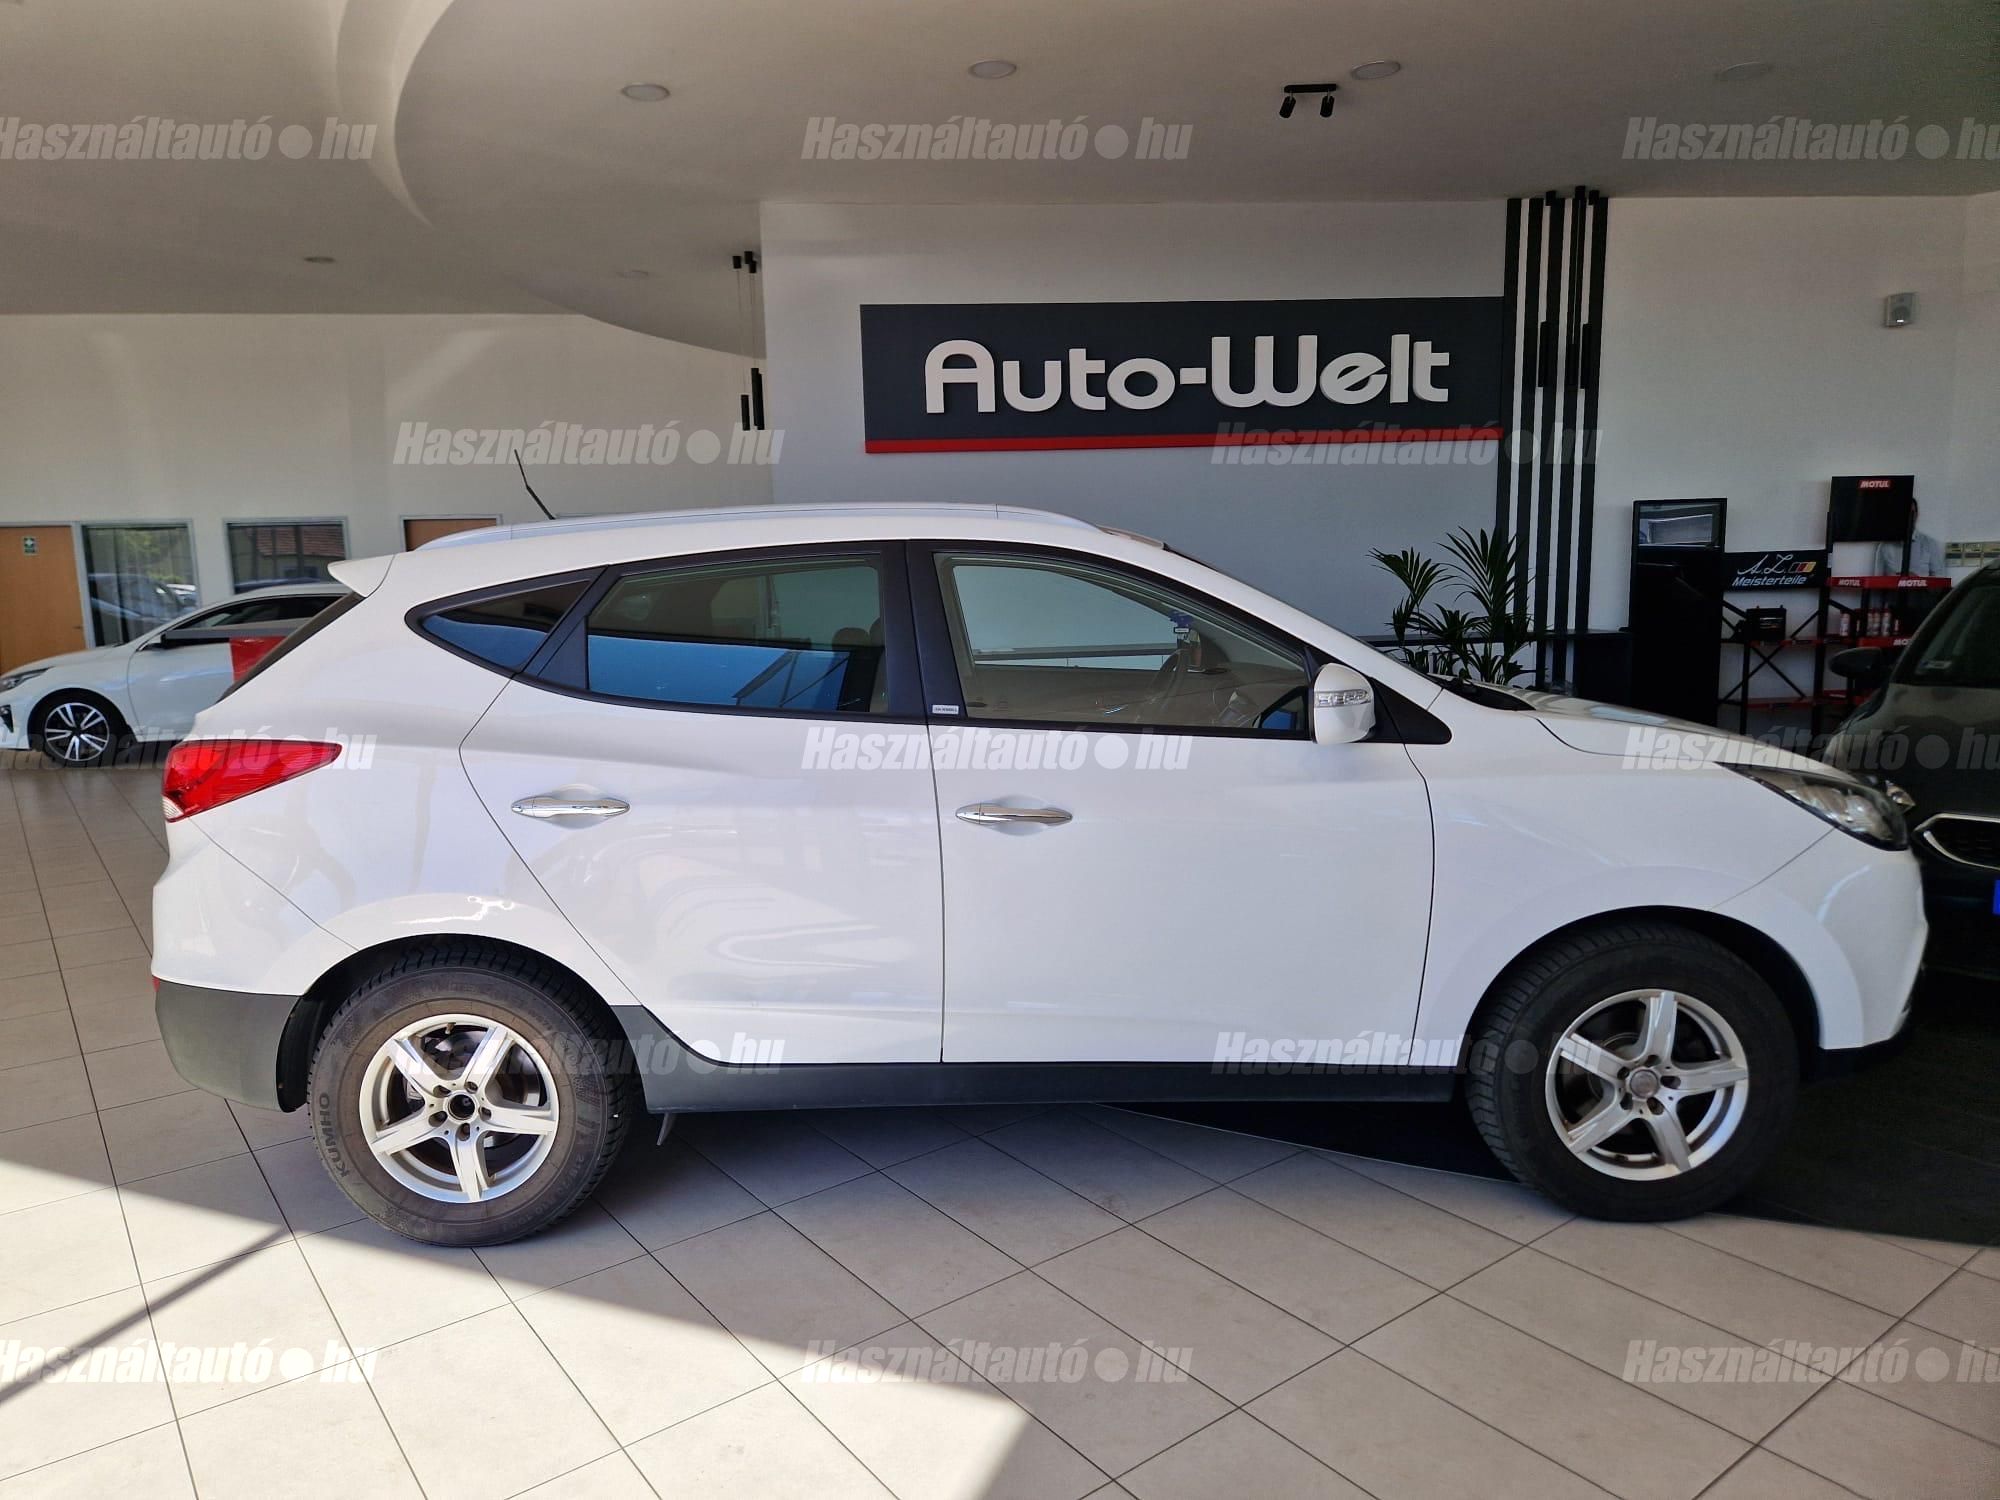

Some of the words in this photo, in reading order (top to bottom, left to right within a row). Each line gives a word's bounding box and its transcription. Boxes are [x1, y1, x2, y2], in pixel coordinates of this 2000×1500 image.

[925, 333, 1450, 414] Auto-Welt
[1860, 480, 1890, 488] MOTUL
[1732, 574, 1807, 587] Meisterteile
[1838, 579, 1861, 587] MOTUL
[1897, 579, 1928, 587] MOTUL
[319, 1092, 350, 1178] KUMHO
